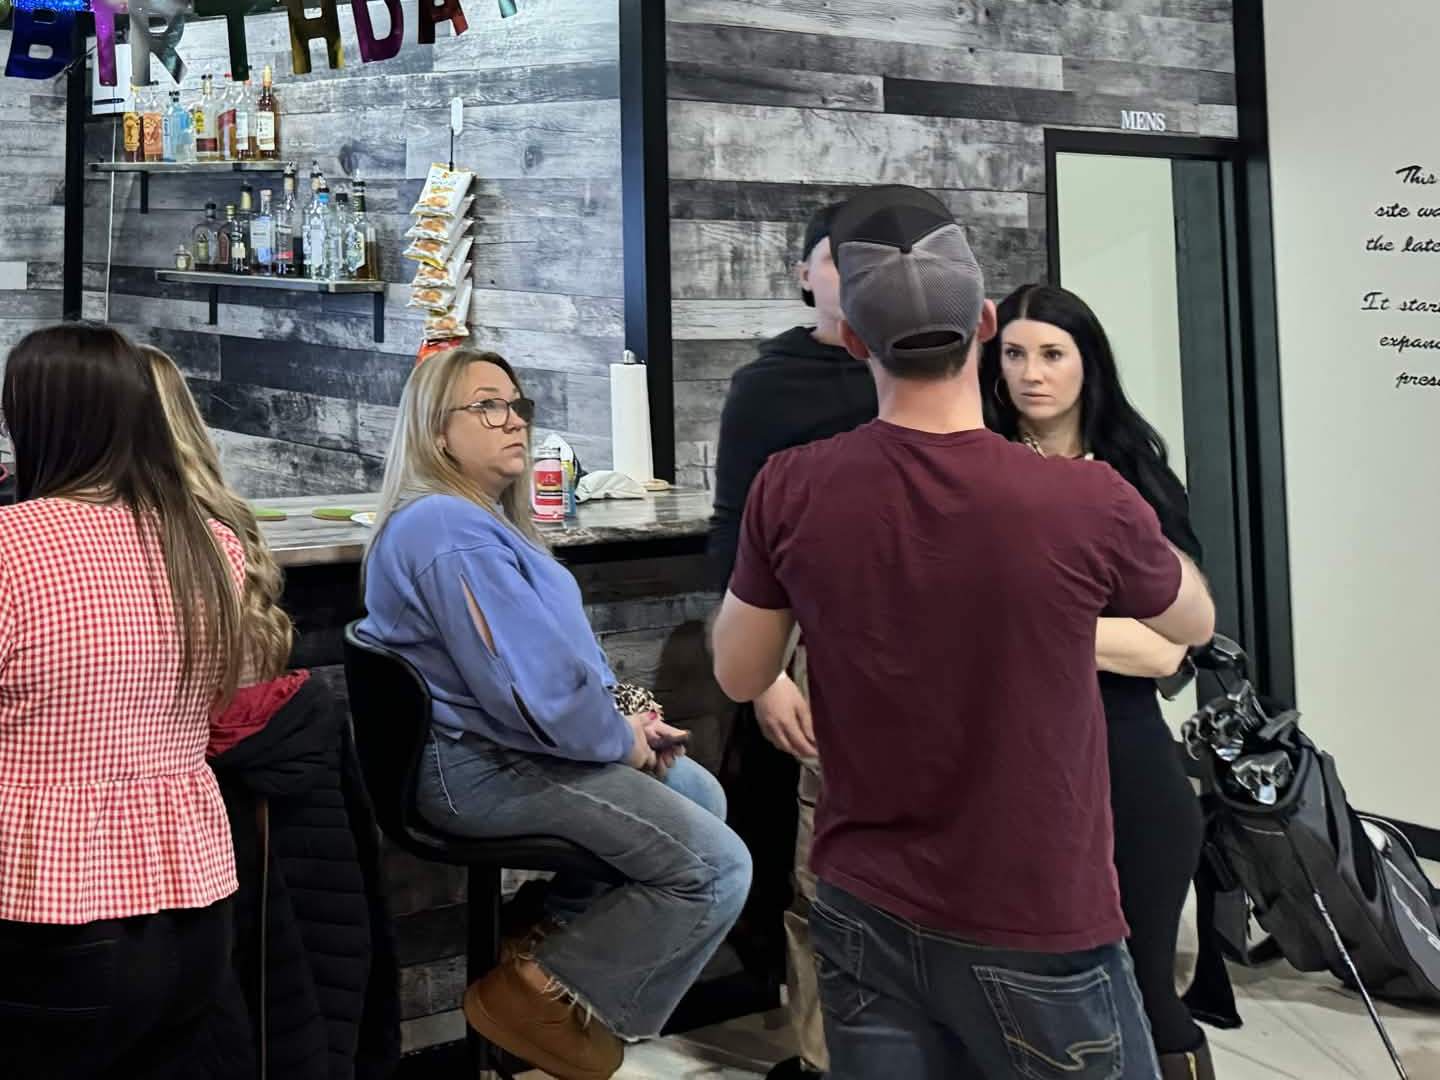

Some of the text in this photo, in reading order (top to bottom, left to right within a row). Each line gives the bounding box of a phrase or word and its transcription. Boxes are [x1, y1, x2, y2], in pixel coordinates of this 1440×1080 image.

[1395, 165, 1437, 185] This
[1374, 203, 1410, 218] site
[1366, 235, 1395, 251] the
[1361, 292, 1391, 311] It
